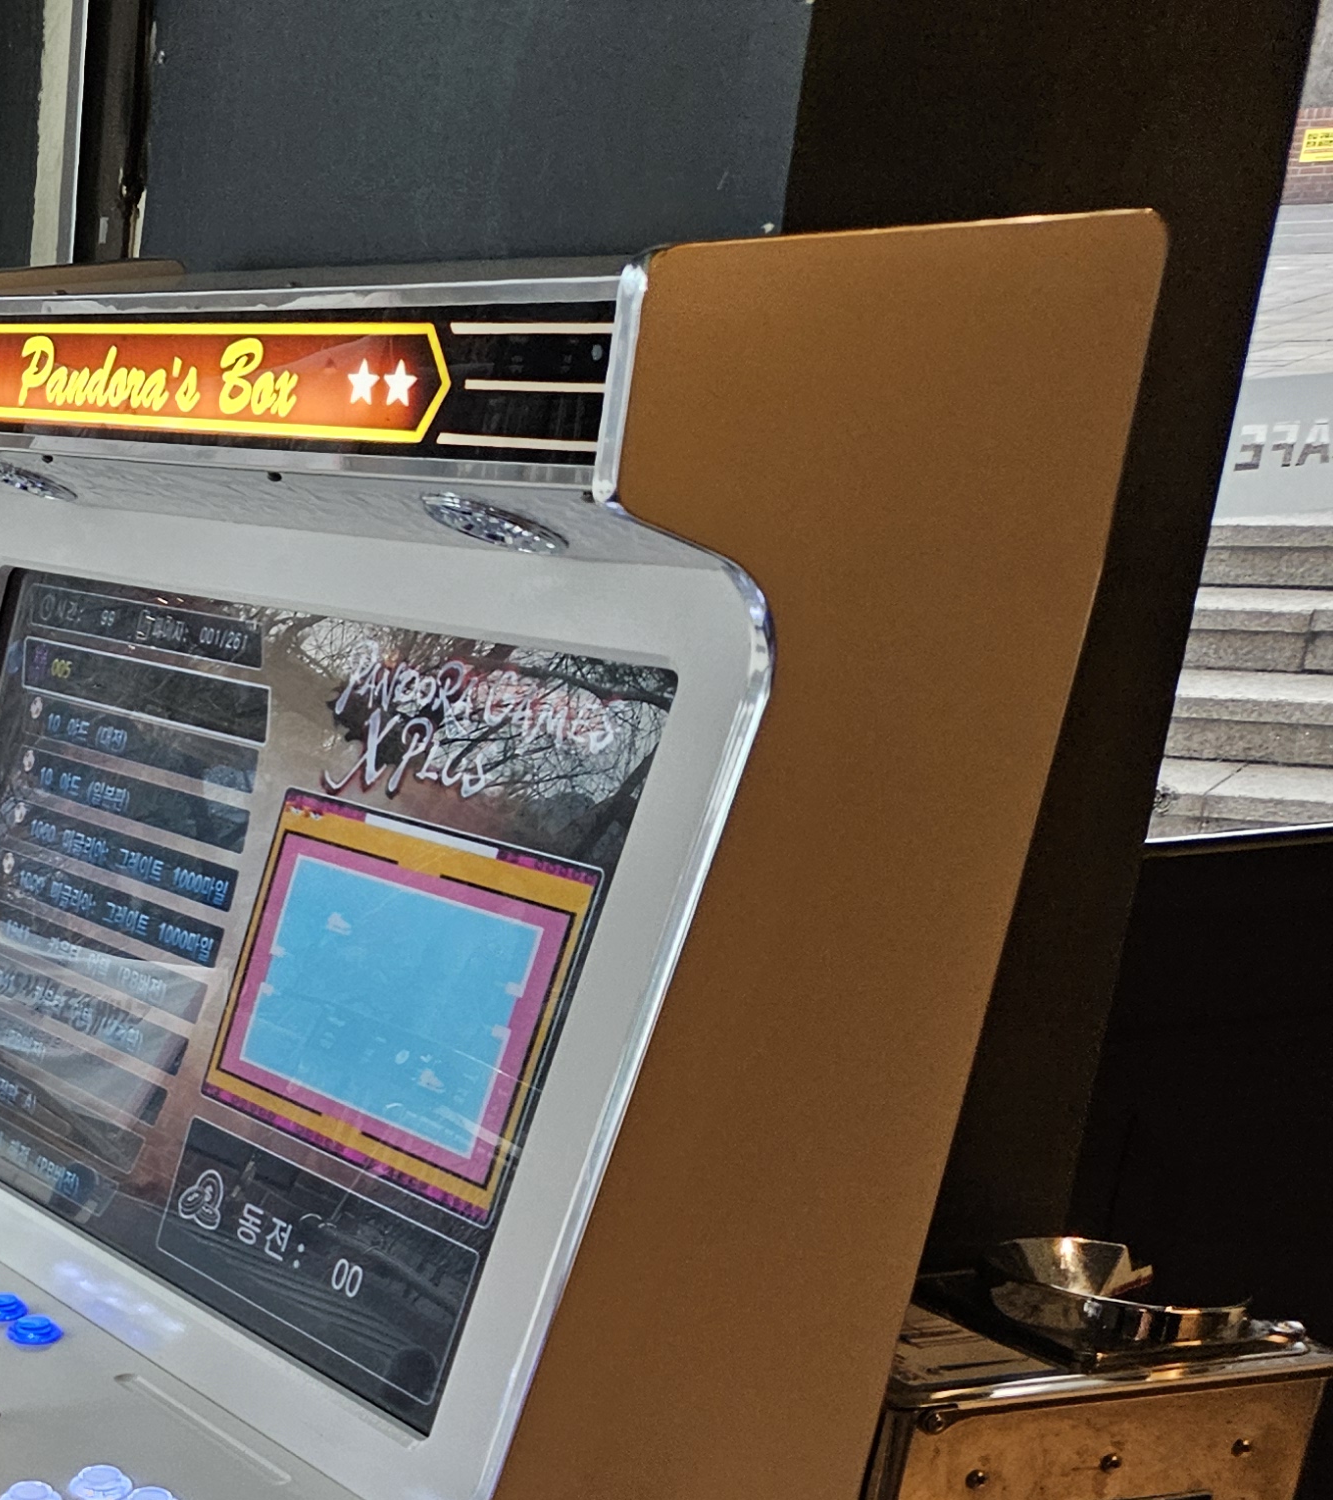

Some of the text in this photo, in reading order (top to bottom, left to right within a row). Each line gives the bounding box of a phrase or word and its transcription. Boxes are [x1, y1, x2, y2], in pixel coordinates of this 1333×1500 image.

[17, 334, 298, 418] Pandora's Box
[100, 610, 116, 627] 99
[47, 712, 61, 732] 10
[40, 766, 54, 787] 10
[236, 1202, 363, 1298] 동전: 00
